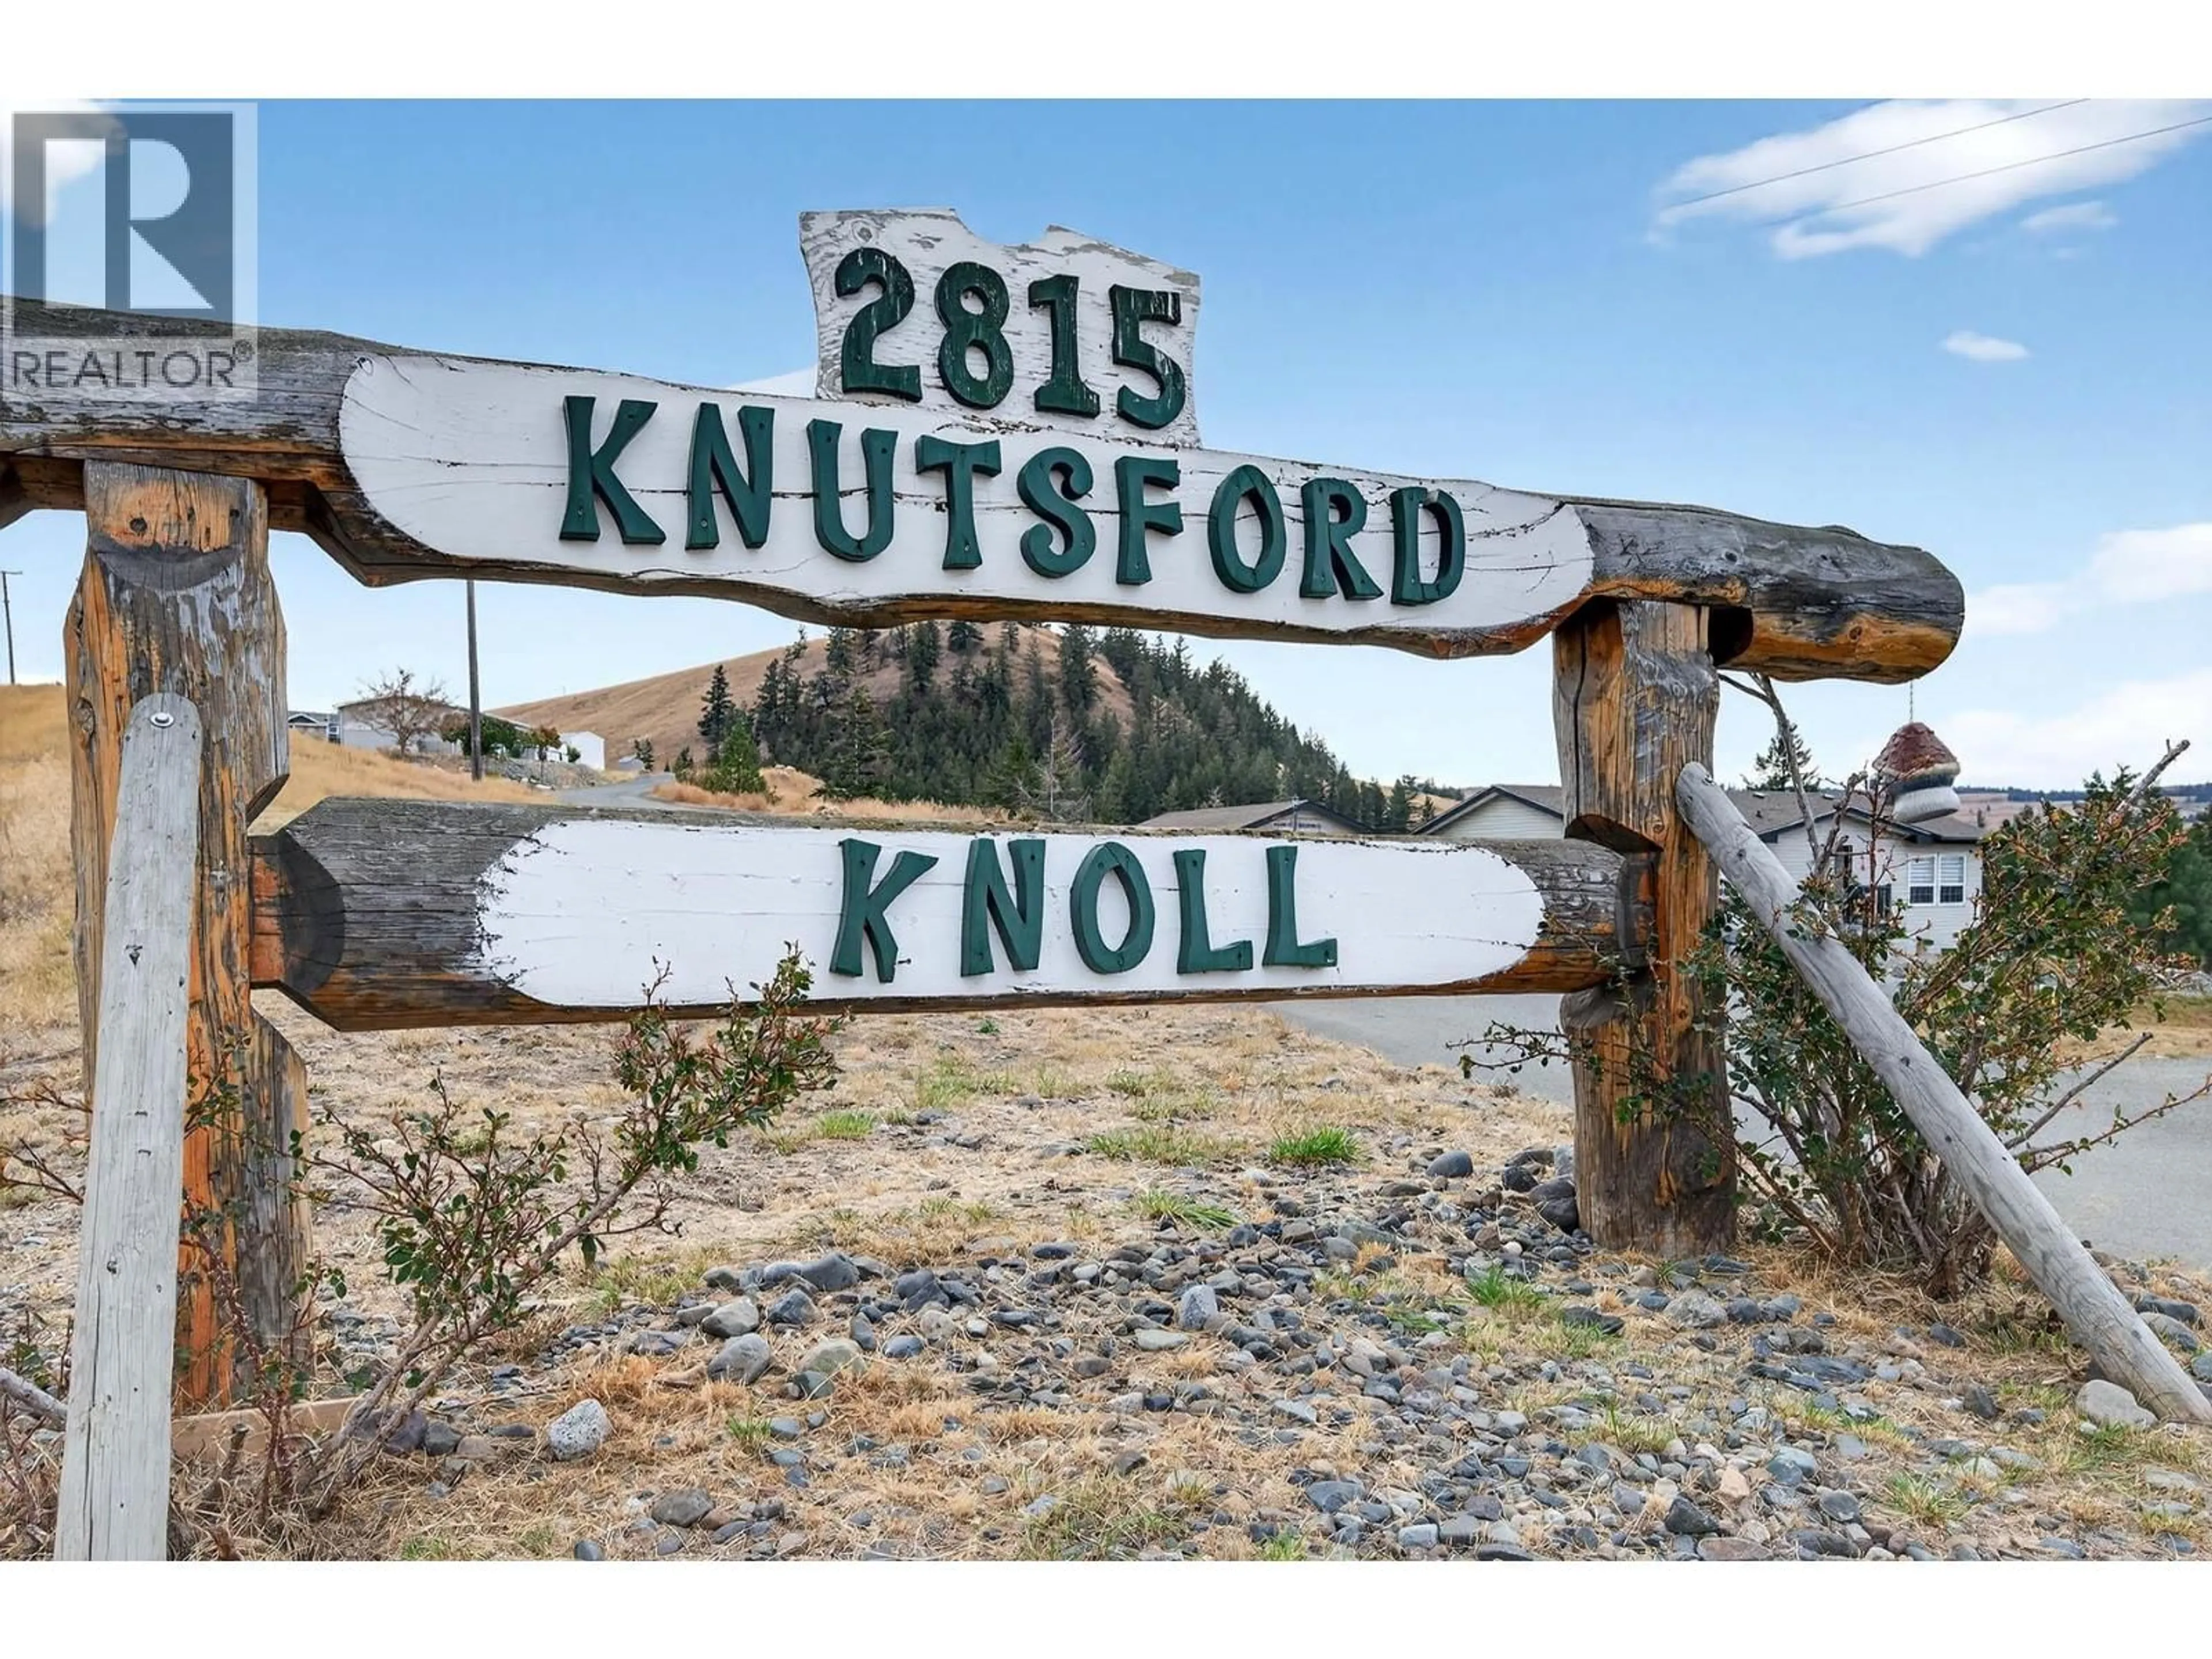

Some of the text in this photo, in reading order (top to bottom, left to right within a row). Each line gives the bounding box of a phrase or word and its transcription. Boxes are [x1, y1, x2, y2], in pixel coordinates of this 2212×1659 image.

[835, 247, 1185, 430] 2815
[559, 395, 1466, 607] KNUTSFORD
[830, 838, 1338, 983] KNOLL
